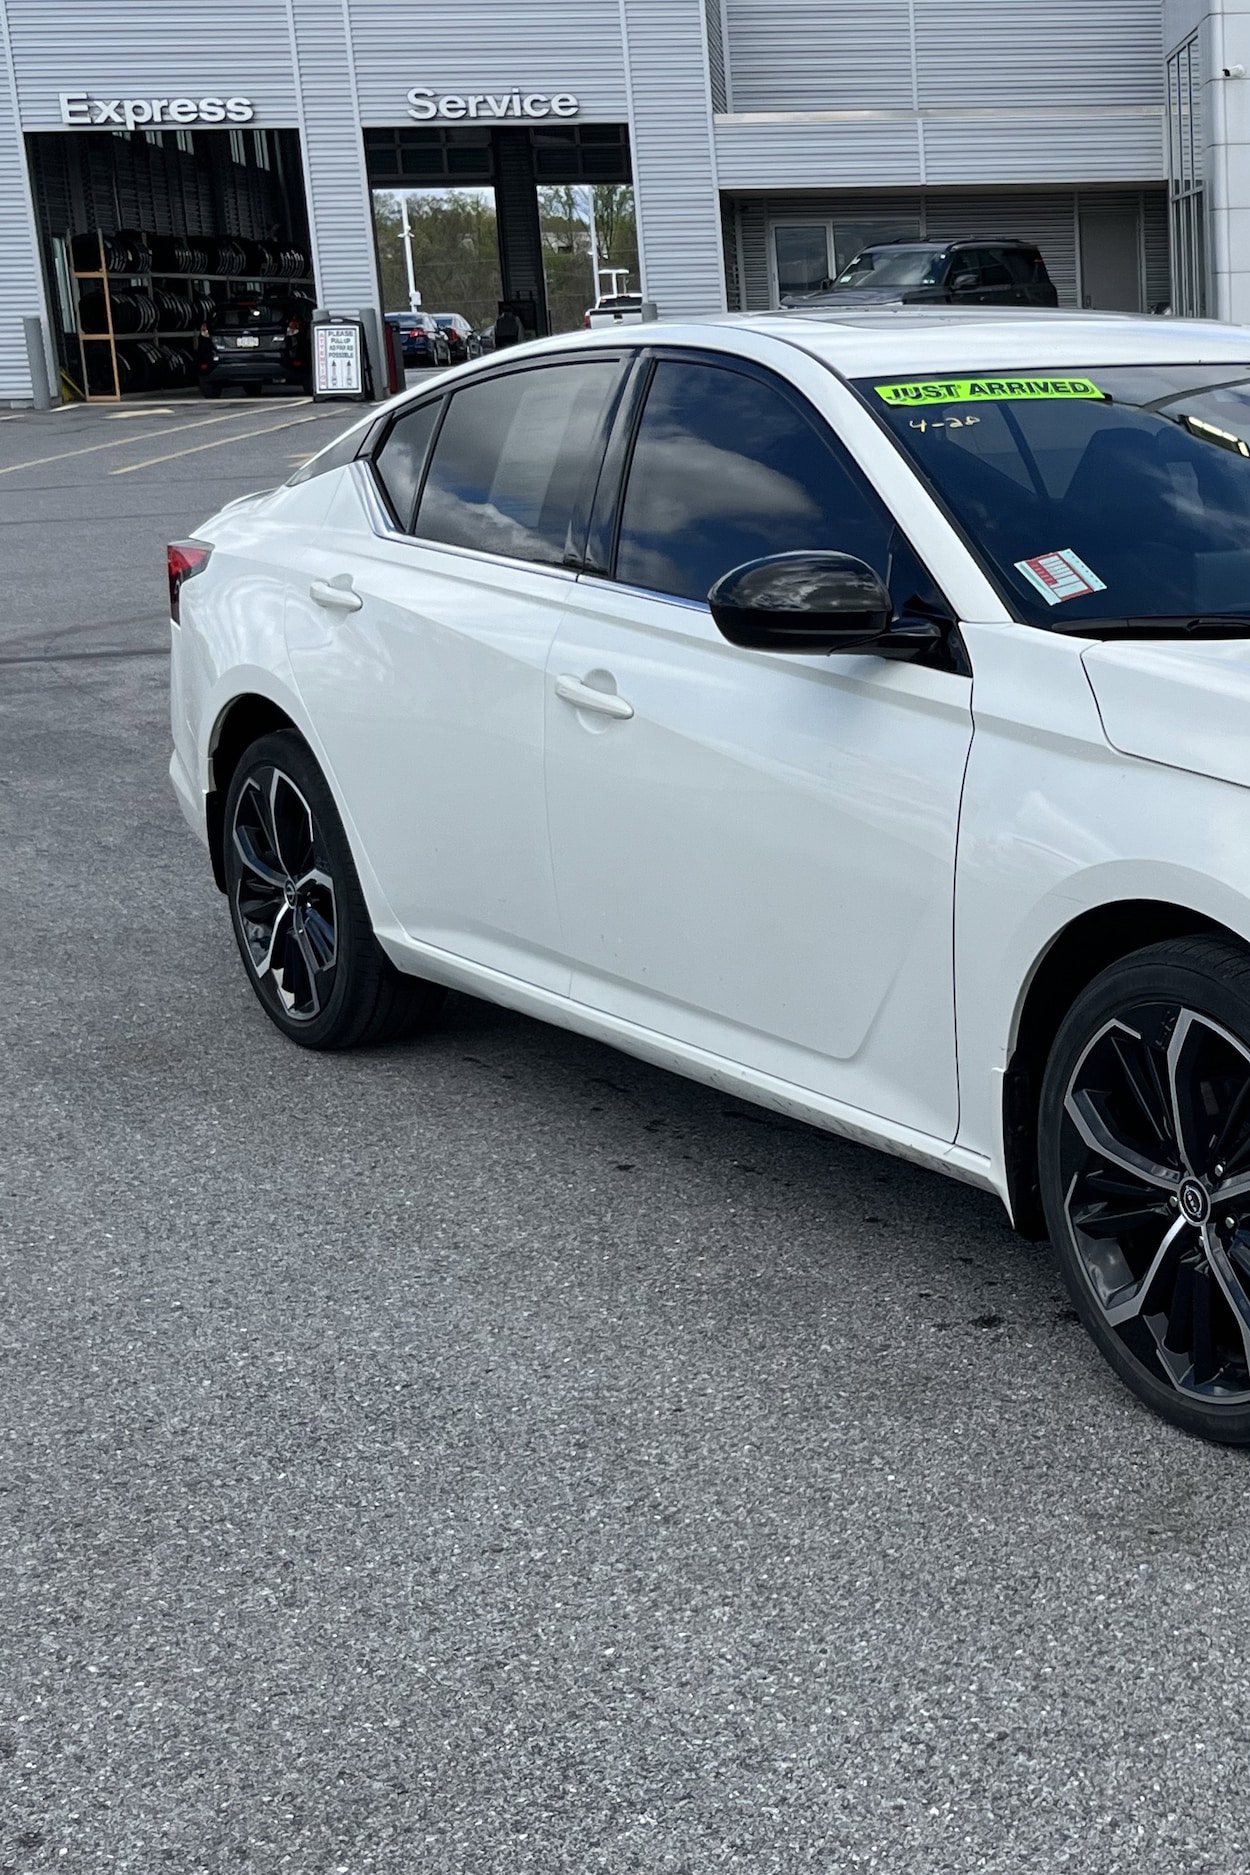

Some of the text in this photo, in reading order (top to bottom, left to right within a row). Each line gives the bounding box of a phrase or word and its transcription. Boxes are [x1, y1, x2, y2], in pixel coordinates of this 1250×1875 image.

[59, 92, 254, 130] Express
[407, 87, 579, 120] Service
[886, 381, 1095, 401] JUST ARRIVED
